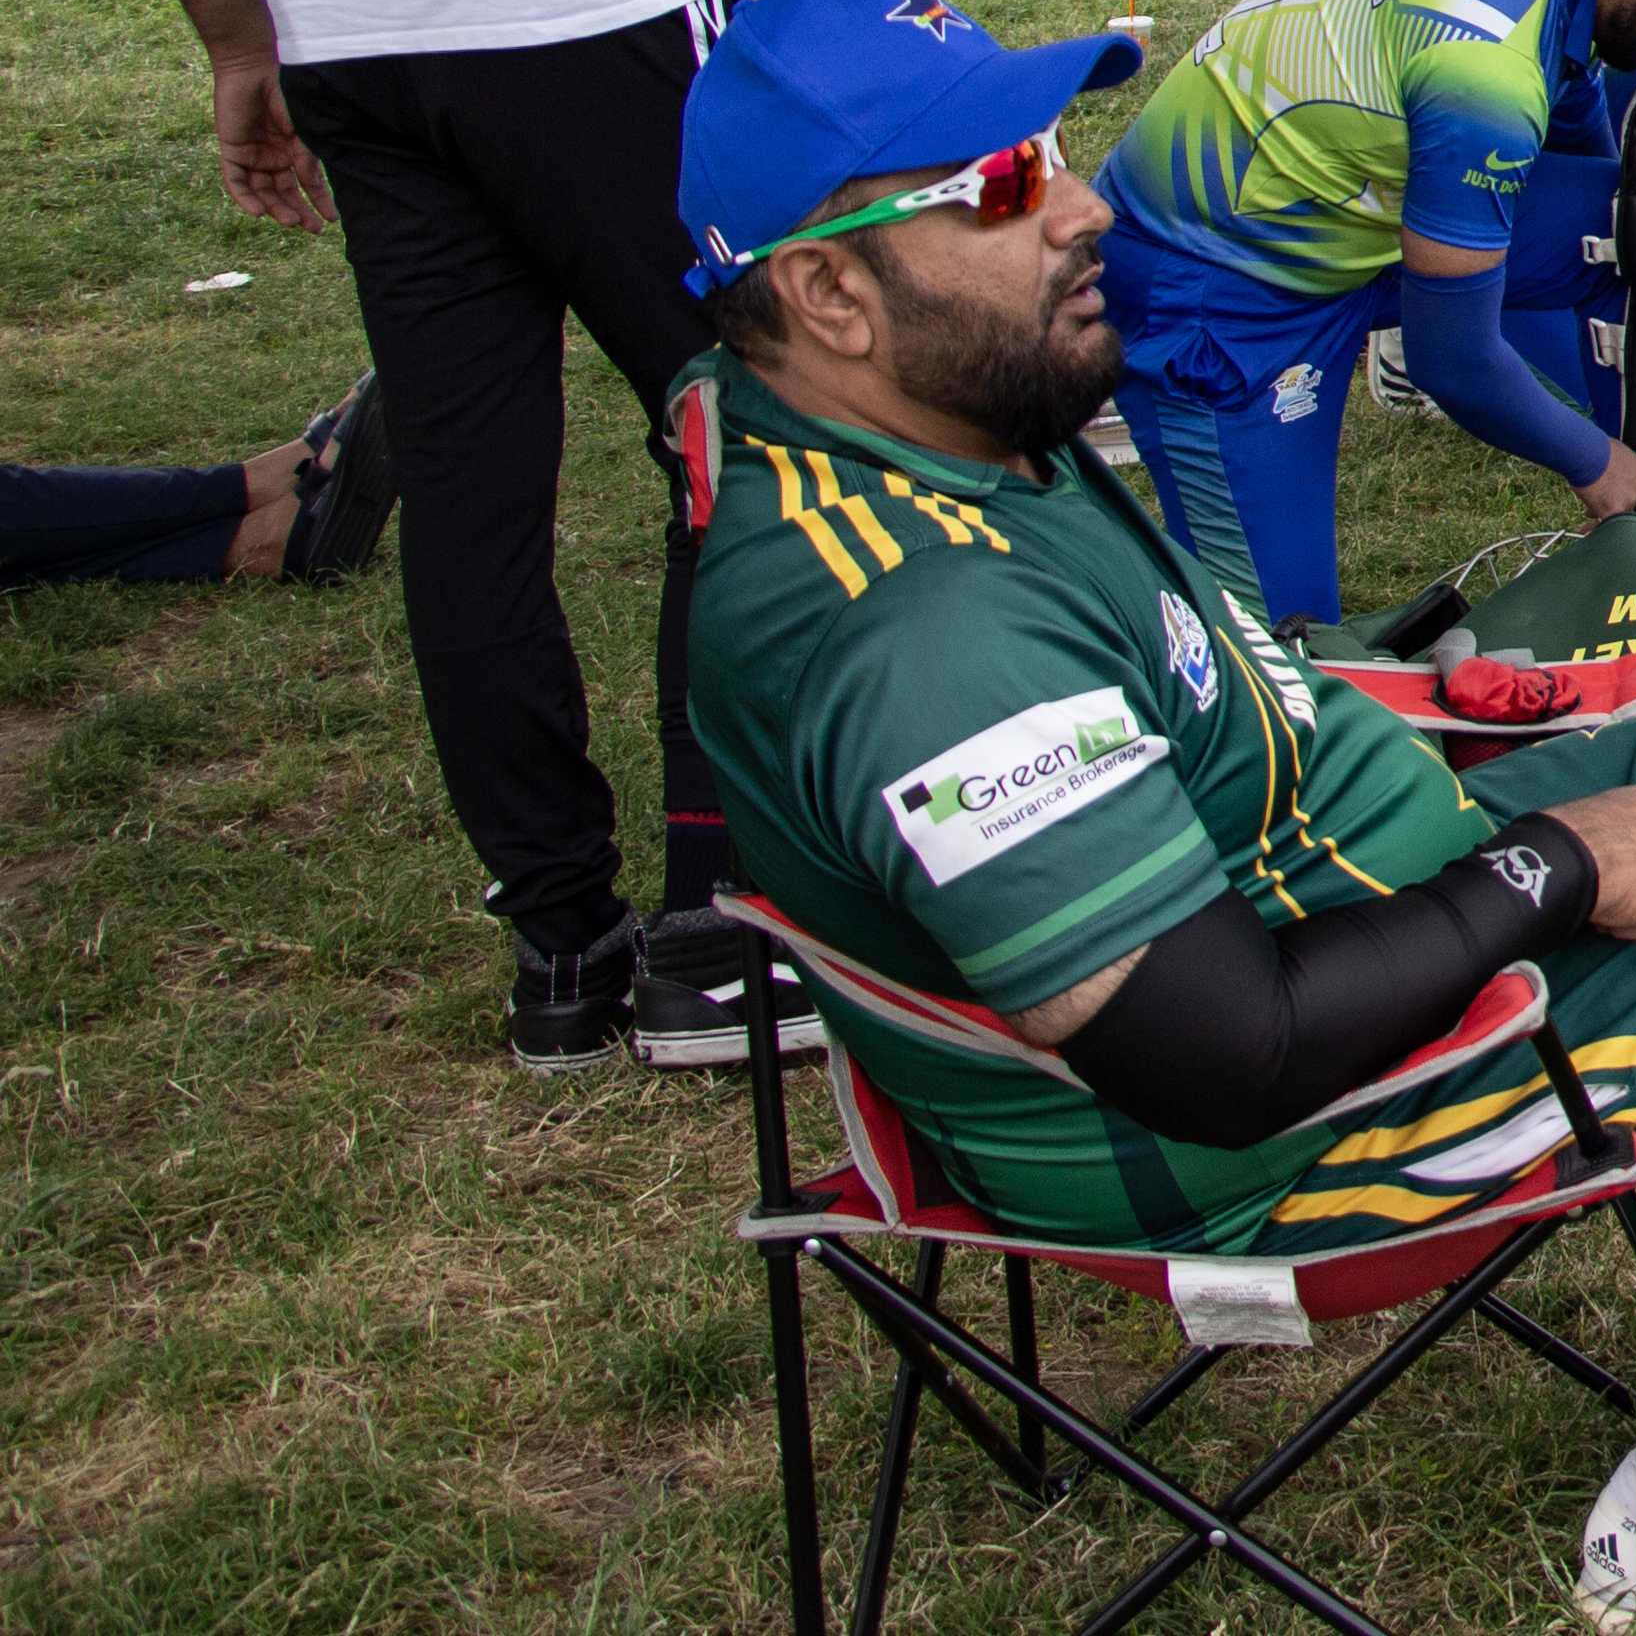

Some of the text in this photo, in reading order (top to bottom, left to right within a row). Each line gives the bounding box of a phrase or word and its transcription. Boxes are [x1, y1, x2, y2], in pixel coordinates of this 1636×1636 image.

[1461, 168, 1499, 192] JUST
[956, 742, 1078, 812] Green
[979, 741, 1148, 841] Insurance Brokerage
[1585, 1545, 1627, 1578] adidas
